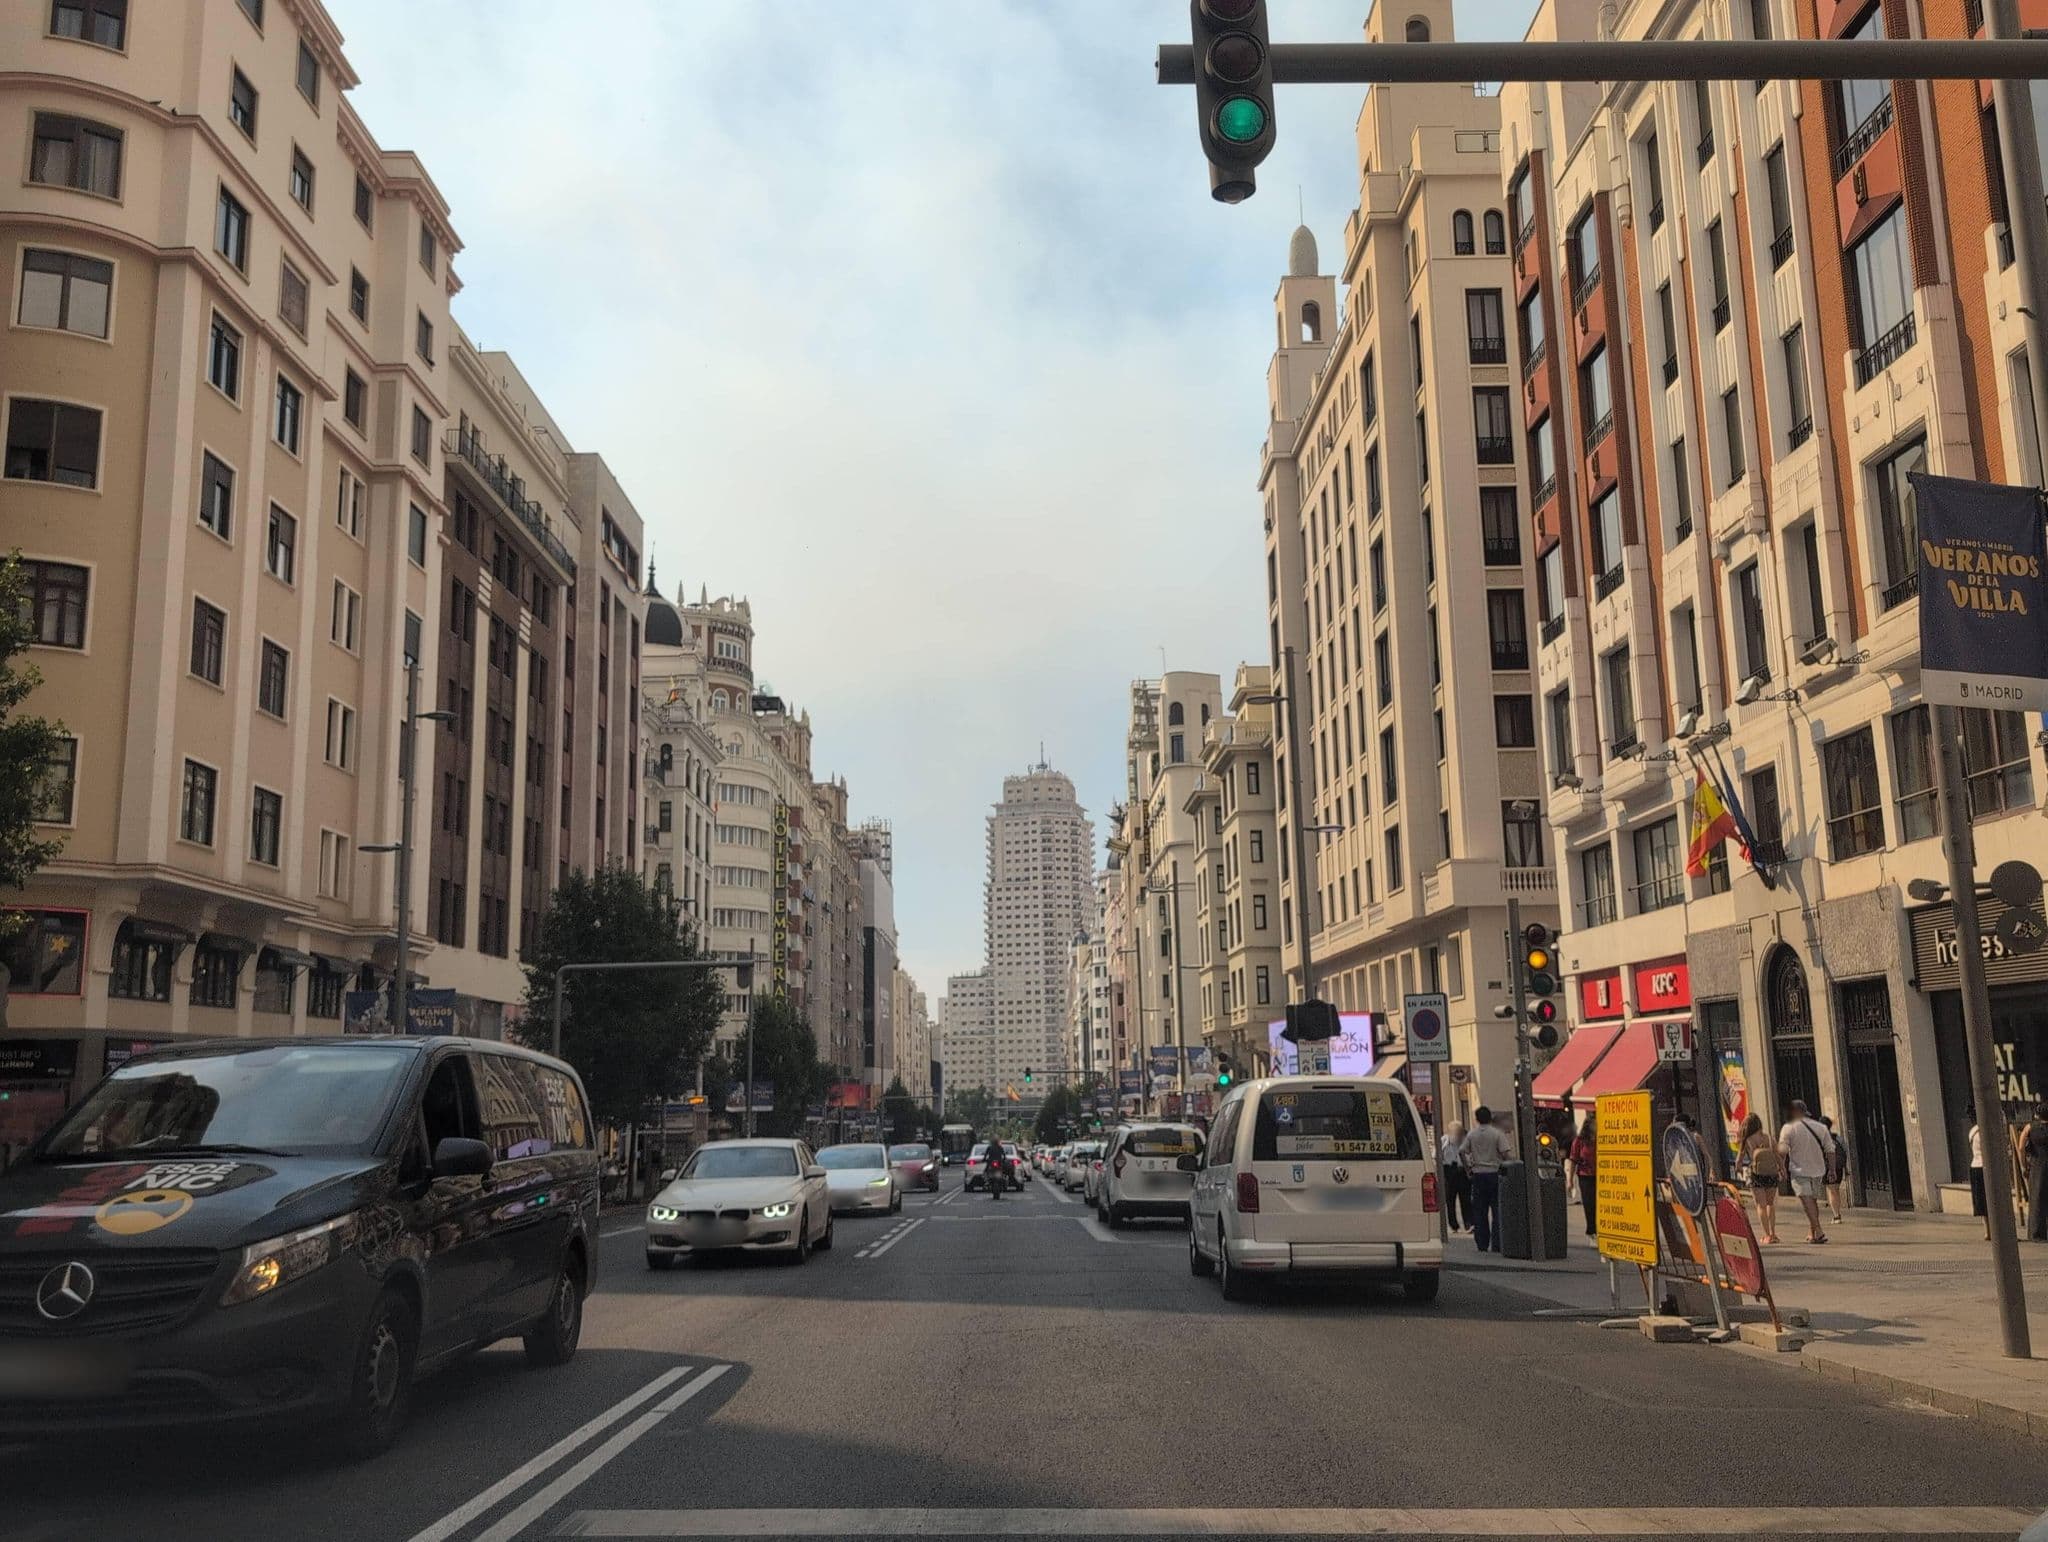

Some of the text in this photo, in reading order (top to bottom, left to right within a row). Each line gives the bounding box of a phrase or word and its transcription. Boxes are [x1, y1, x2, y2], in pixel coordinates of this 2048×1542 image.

[1946, 539, 1980, 548] VERANOS
[1921, 539, 2039, 578] VERANOS
[1968, 575, 2000, 587] DE LA
[1947, 579, 2028, 615] VILLA
[1975, 686, 2024, 700] MADRID
[774, 804, 788, 889] HOTEL
[1652, 972, 1675, 995] KFC
[408, 1007, 453, 1017] VERANOS
[1664, 1051, 1687, 1059] KFC
[1994, 1043, 2014, 1071] AT
[1997, 1074, 2041, 1102] EAL.
[1604, 1098, 1639, 1113] ATENCIÓN
[551, 1106, 571, 1144] NIC
[1604, 1119, 1638, 1130] CALLE SILVA
[1619, 1135, 1630, 1144] POR
[1631, 1134, 1648, 1144] OBRAS
[1334, 1142, 1395, 1152] 91 547 82 00
[123, 1174, 224, 1190] NIC
